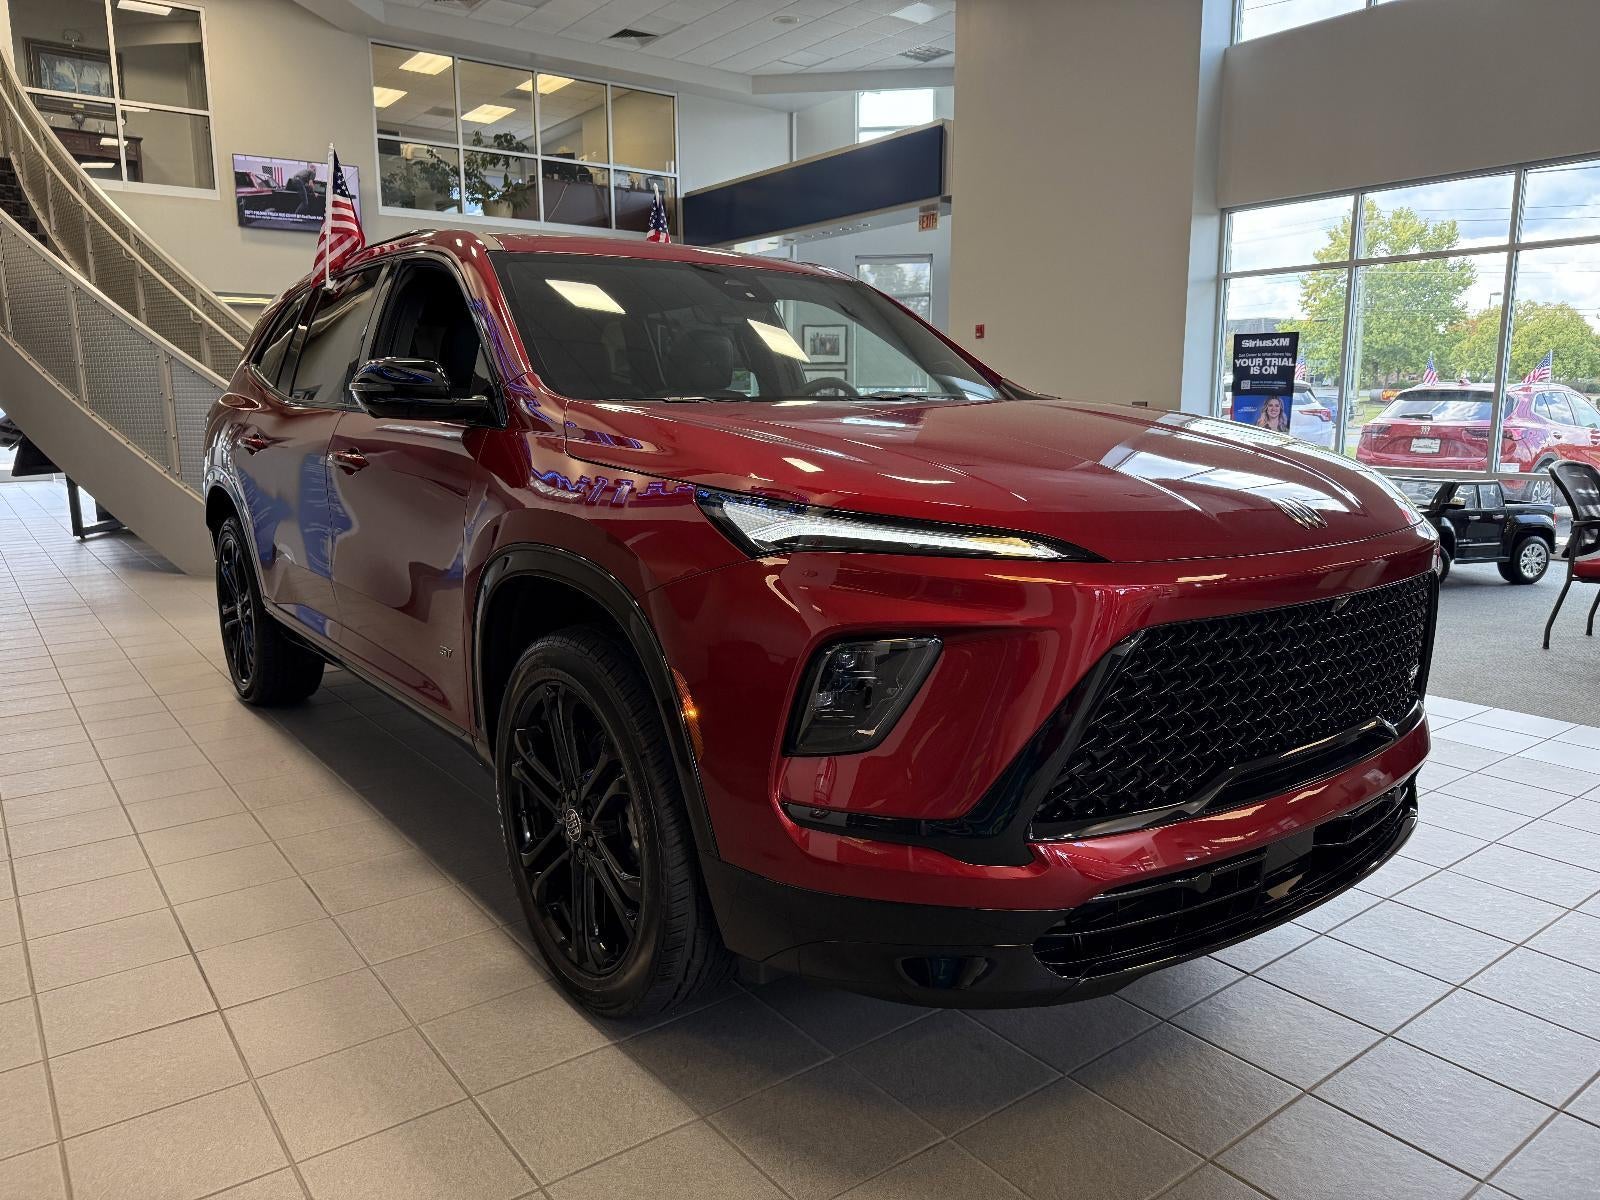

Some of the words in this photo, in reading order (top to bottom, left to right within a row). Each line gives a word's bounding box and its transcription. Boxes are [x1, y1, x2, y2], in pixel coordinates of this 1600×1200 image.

[921, 213, 935, 229] EXIT
[1241, 338, 1290, 347] SiriusXM
[1235, 358, 1263, 367] YOUR
[1265, 357, 1295, 366] TRIAL
[1250, 366, 1261, 375] IS
[1261, 366, 1278, 375] ON
